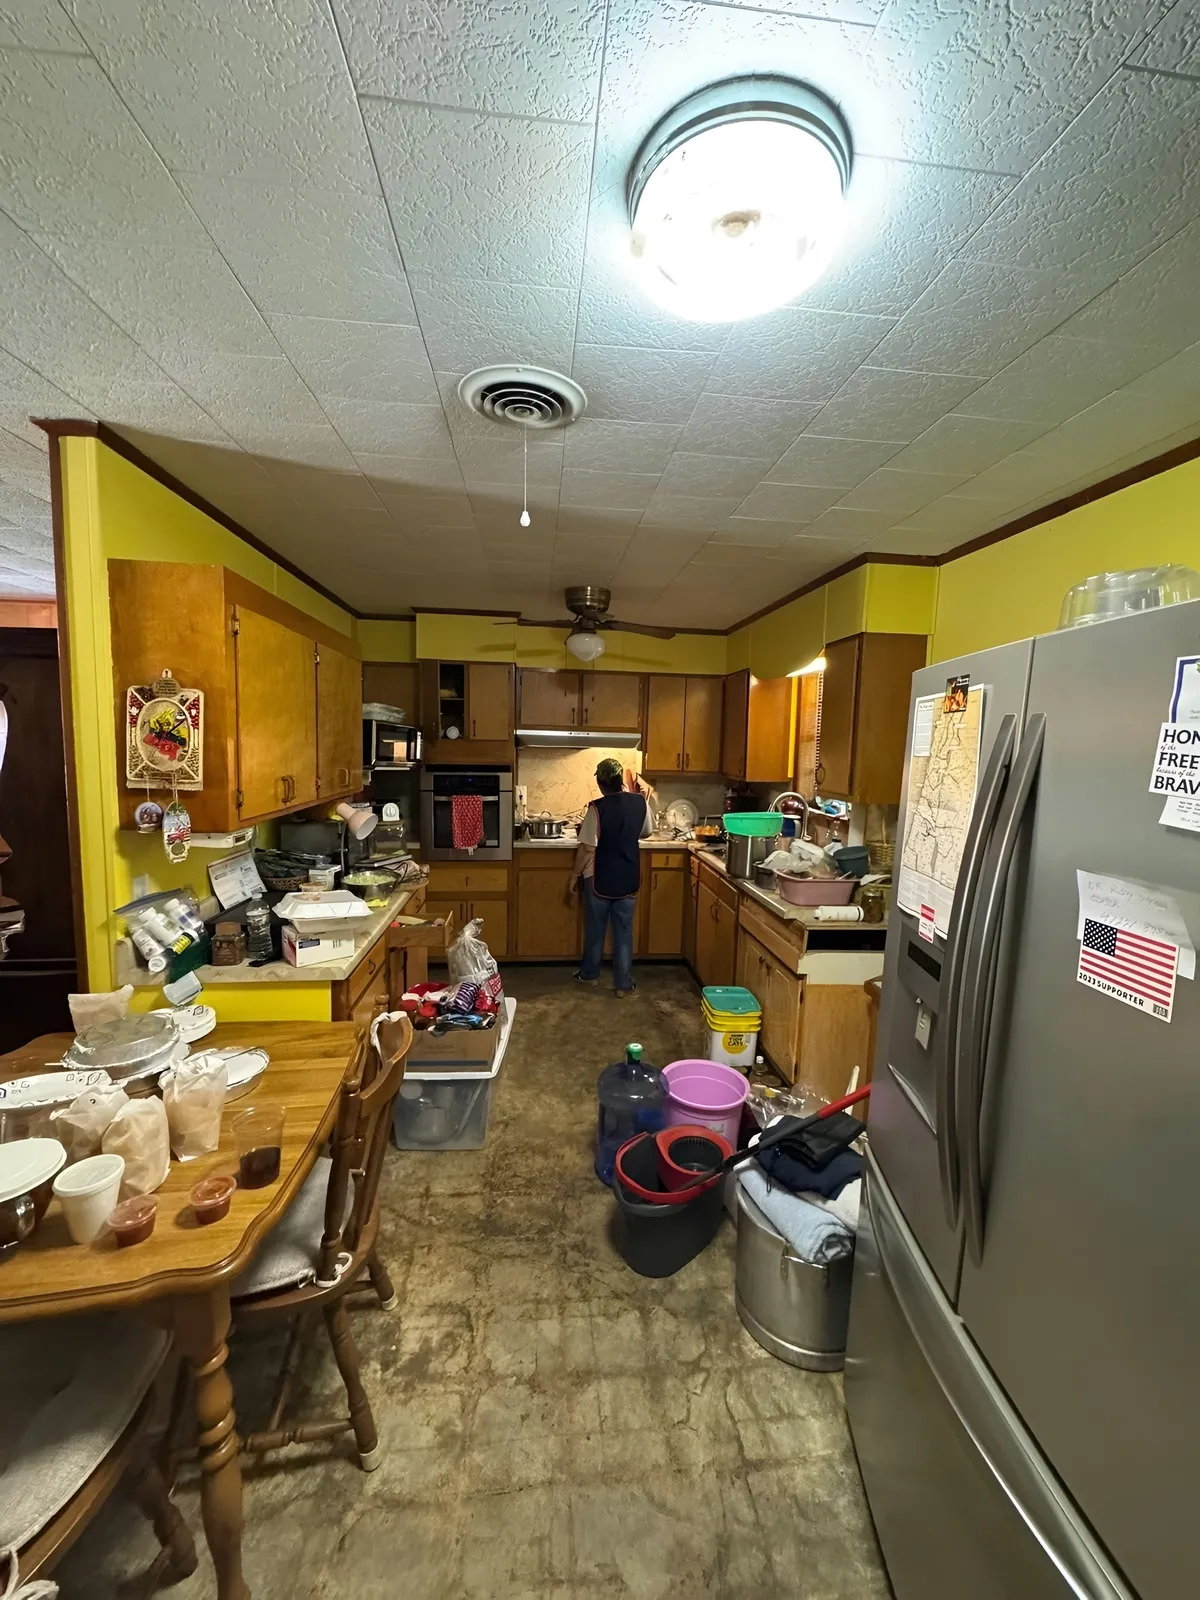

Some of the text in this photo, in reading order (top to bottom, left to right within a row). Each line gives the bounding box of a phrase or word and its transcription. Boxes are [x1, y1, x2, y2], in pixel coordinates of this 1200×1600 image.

[1158, 752, 1200, 769] FREE
[1079, 972, 1145, 1007] 2023 SUPPORTER
